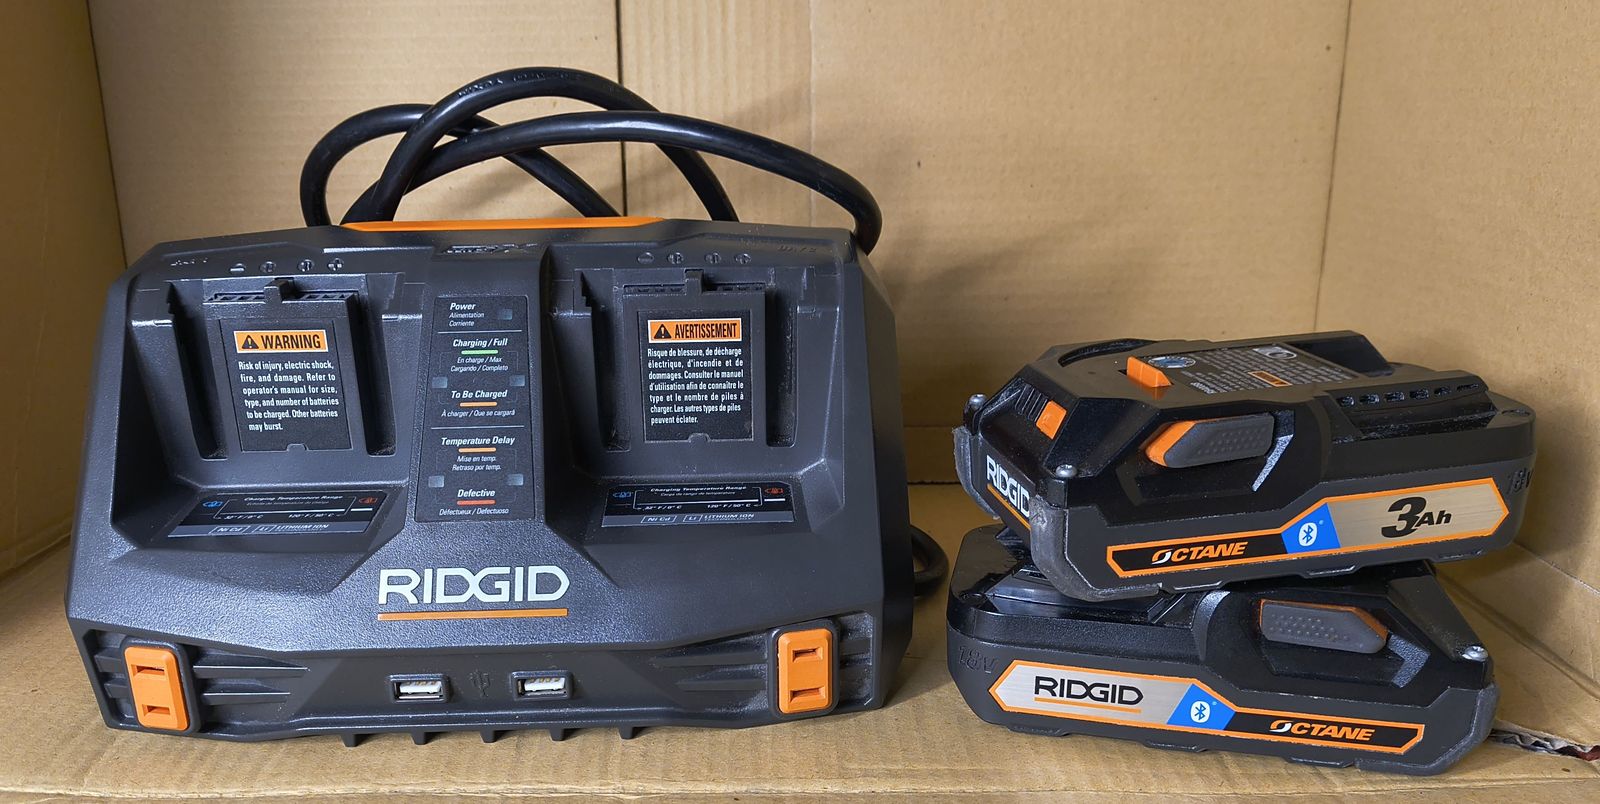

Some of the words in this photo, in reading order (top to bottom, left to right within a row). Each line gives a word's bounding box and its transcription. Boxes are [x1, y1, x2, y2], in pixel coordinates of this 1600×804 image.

[675, 323, 737, 338] AVERTISSEMENT
[261, 335, 320, 349] WARNING
[453, 339, 487, 348] Charging
[494, 338, 508, 346] Full
[648, 349, 667, 358] Risque
[669, 348, 676, 356] de
[678, 348, 704, 356] blessure,
[714, 347, 741, 357] décharge
[262, 361, 283, 371] injury,
[285, 361, 310, 369] electric
[312, 360, 334, 369] shock,
[648, 360, 683, 370] électrique,
[687, 359, 721, 367] d'incendie
[736, 358, 743, 366] de
[240, 374, 255, 382] fire,
[274, 374, 304, 383] damage.
[649, 371, 683, 380] dommages.
[684, 370, 713, 378] Consulter
[714, 370, 719, 378] le
[721, 369, 743, 378] manuel
[243, 386, 278, 396] operator's
[281, 385, 306, 393] manual
[308, 385, 318, 393] for
[321, 385, 337, 393] size,
[686, 382, 697, 390] afin
[475, 390, 507, 399] Charged
[650, 395, 663, 403] type
[676, 393, 681, 401] le
[722, 392, 737, 402] piles
[245, 399, 261, 408] type,
[262, 398, 274, 406] and
[310, 397, 339, 405] batteries
[264, 410, 291, 419] charged.
[310, 409, 338, 417] batteries
[651, 406, 673, 414] charger.
[703, 404, 718, 413] types
[727, 403, 740, 413] piles
[651, 416, 675, 425] peuvent
[676, 415, 698, 423] éclater.
[249, 423, 262, 432] may
[264, 422, 283, 430] burst.
[441, 437, 490, 447] Temperature
[492, 436, 515, 445] Delay
[987, 455, 1030, 517] RIDGID
[458, 489, 495, 497] Defective
[1151, 542, 1248, 565] OCTANE
[378, 565, 570, 605] RIDGID
[1034, 676, 1144, 705] RIDGID
[1269, 720, 1375, 741] OCTANE
